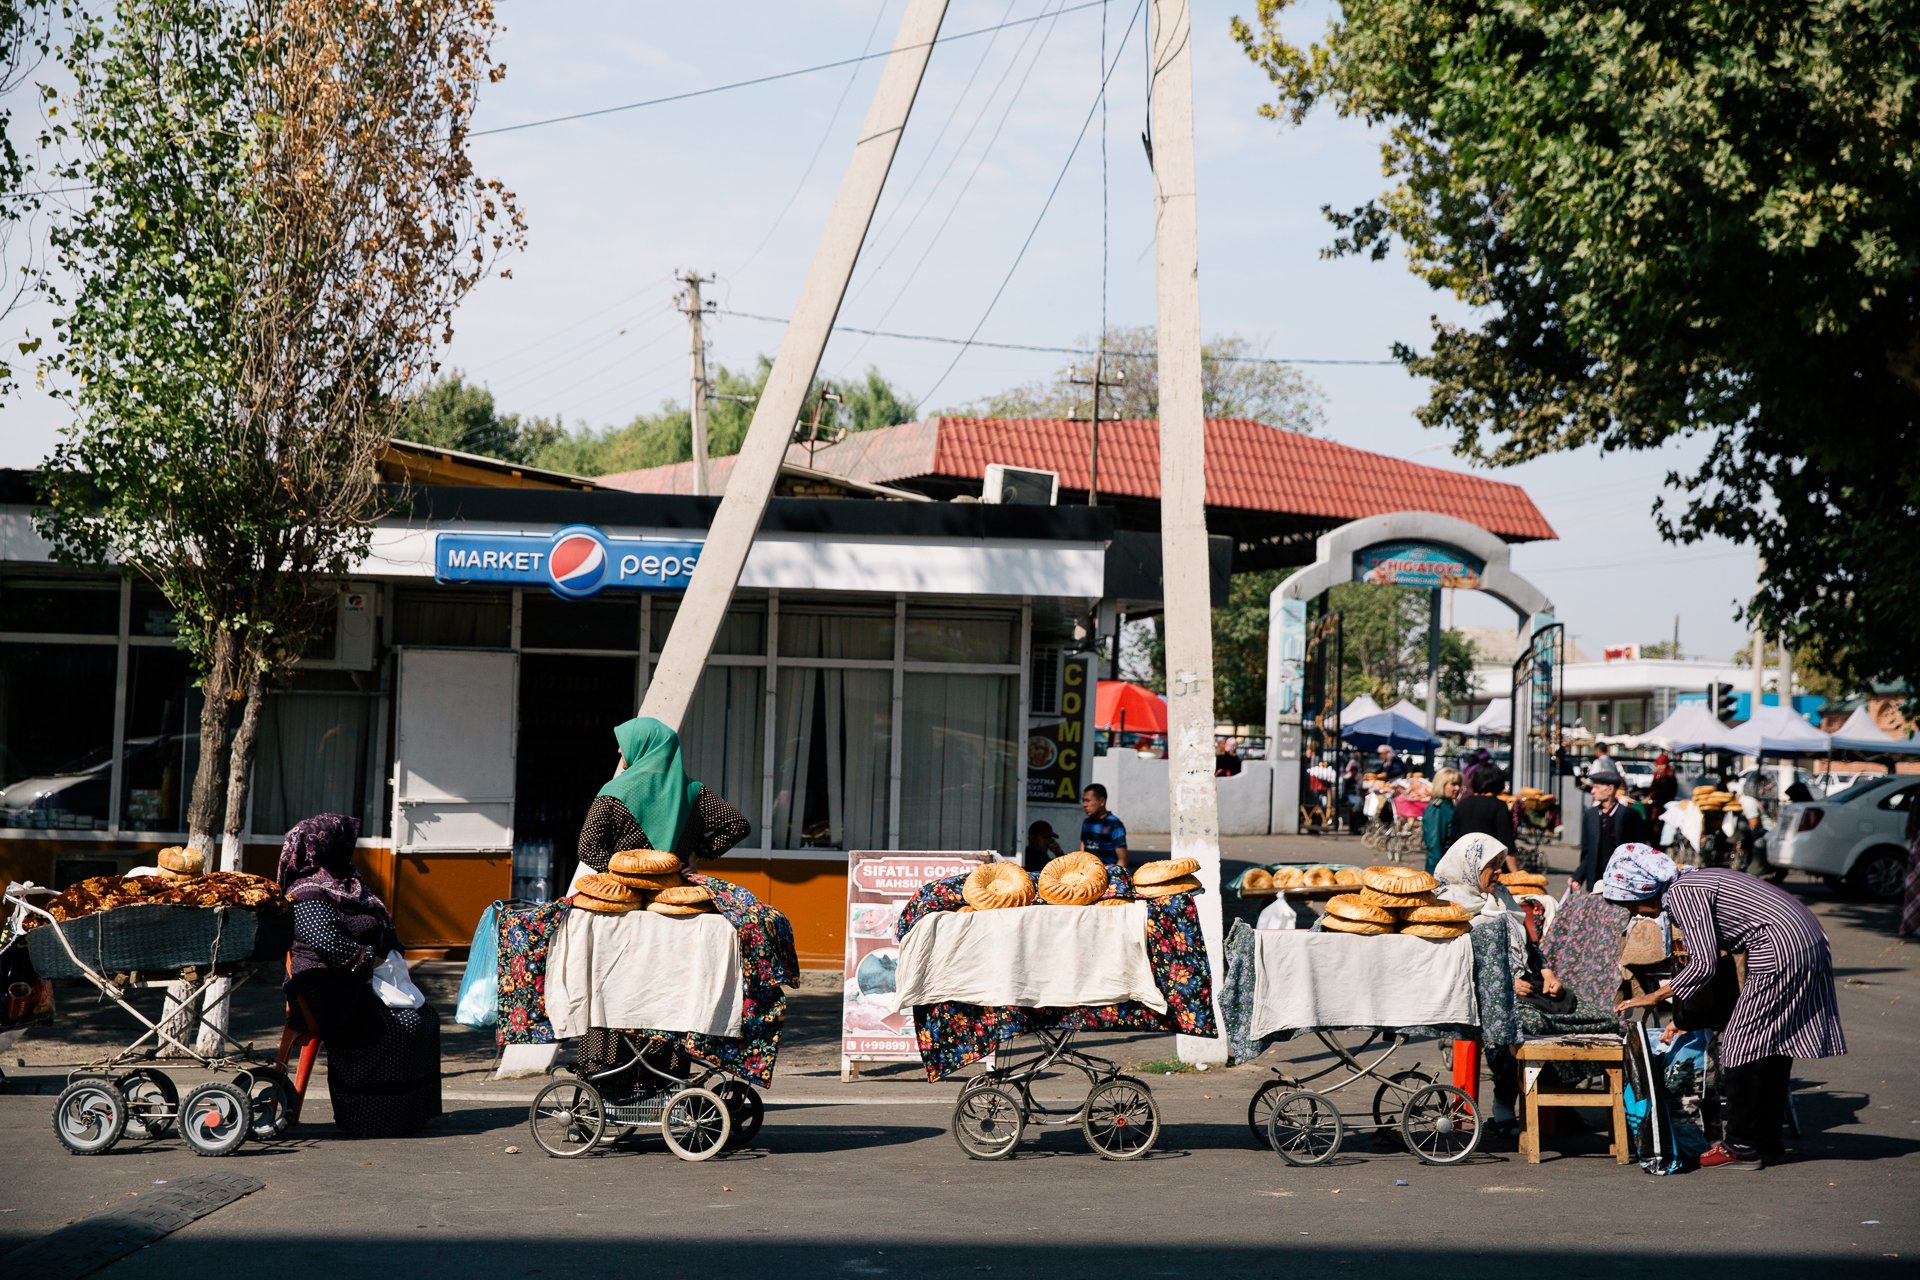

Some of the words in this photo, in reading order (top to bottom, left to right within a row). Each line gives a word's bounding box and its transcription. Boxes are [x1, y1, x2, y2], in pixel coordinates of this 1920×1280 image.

[447, 550, 545, 571] MARKET
[619, 554, 698, 582] peps
[863, 865, 919, 877] SIFATLI
[860, 1041, 910, 1052] (+99899)
